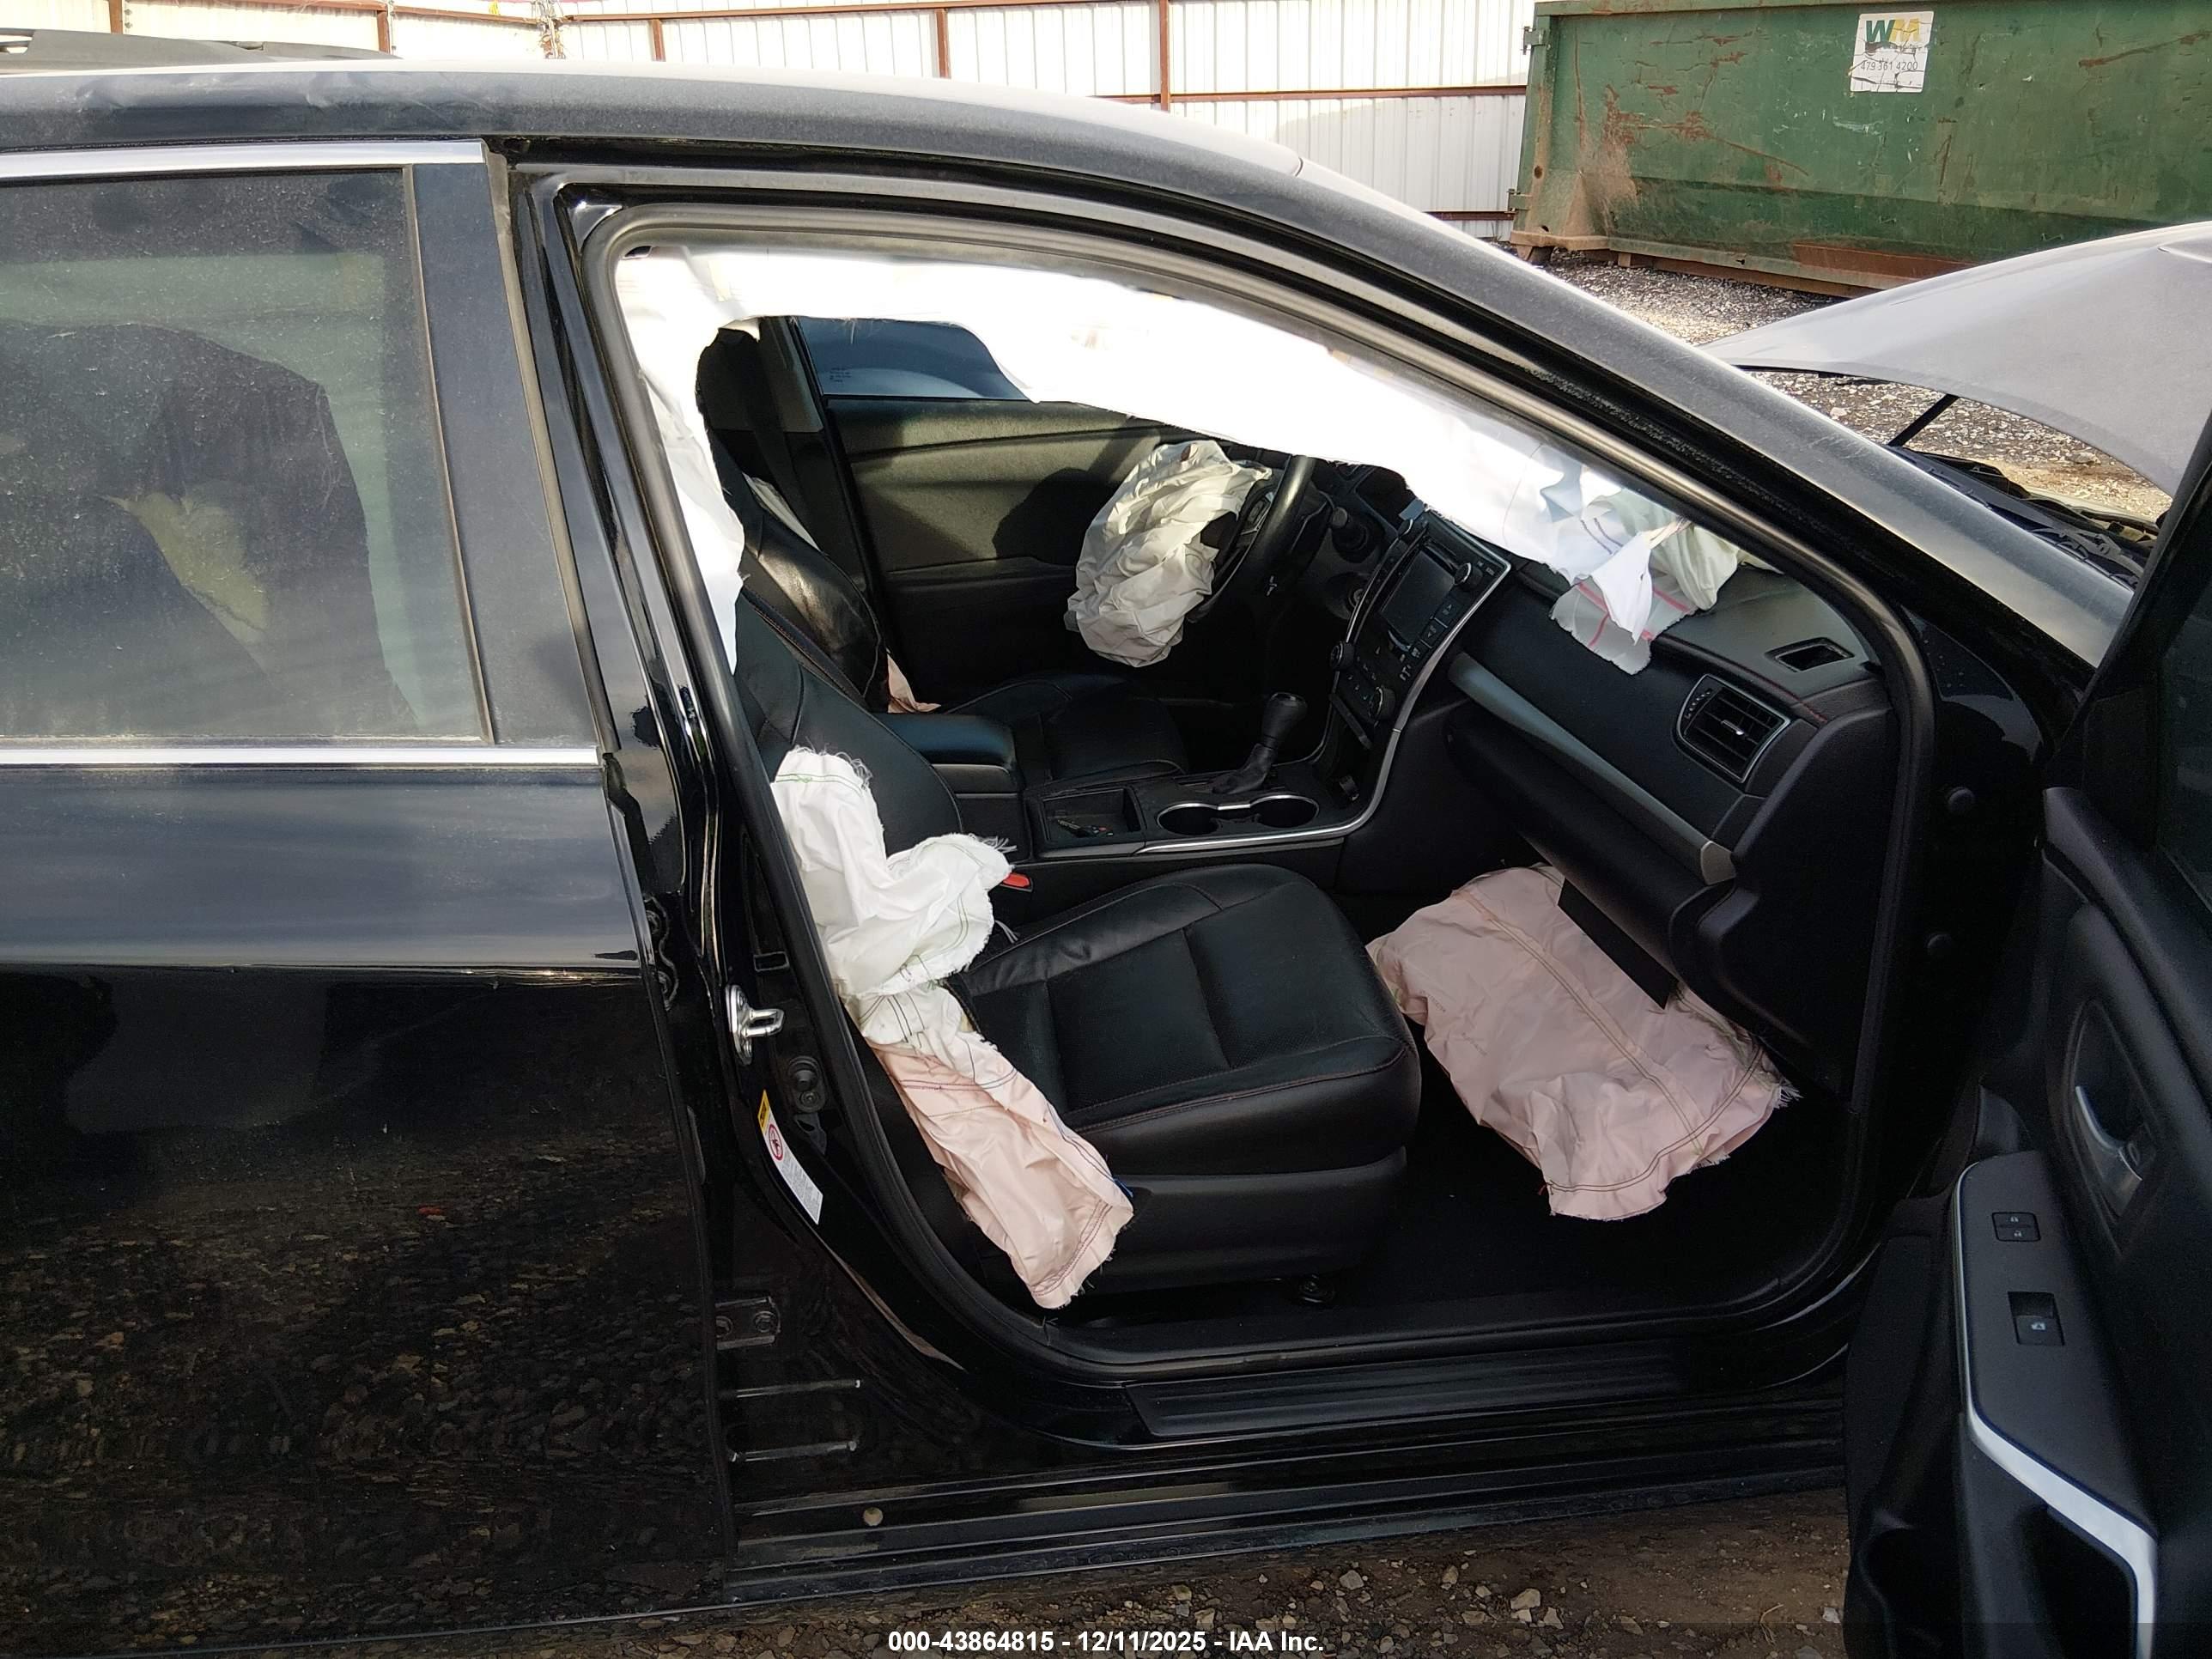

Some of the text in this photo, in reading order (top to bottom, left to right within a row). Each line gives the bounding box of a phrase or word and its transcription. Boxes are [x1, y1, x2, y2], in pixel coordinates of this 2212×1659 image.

[1866, 19, 1920, 43] WM
[1861, 61, 1876, 70] 479
[1896, 61, 1917, 70] 4200
